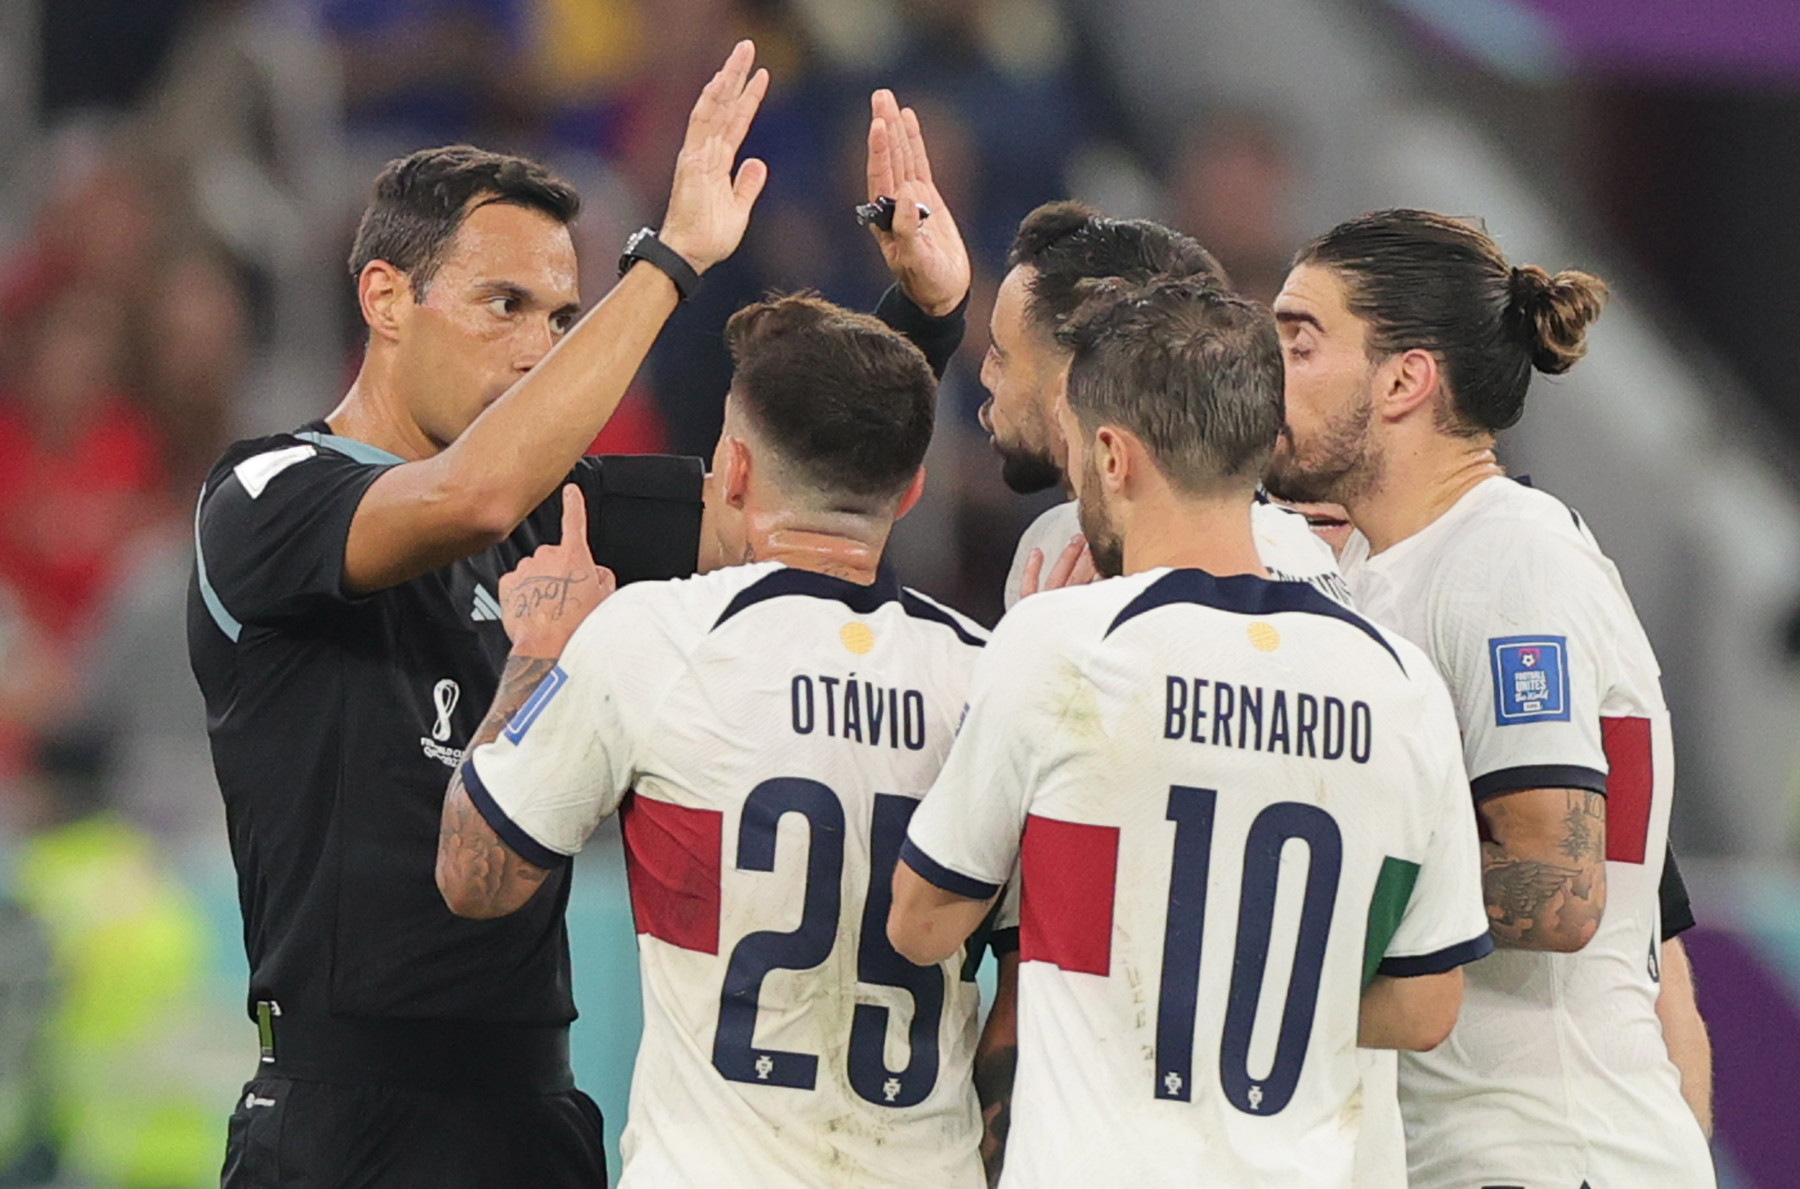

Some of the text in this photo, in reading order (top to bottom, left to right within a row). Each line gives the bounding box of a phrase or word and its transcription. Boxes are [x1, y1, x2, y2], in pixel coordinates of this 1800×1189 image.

[791, 672, 926, 751] OTÁVIO
[1163, 675, 1372, 764] BERNARDO
[712, 776, 945, 1108] 25
[1154, 784, 1343, 1117] 10
